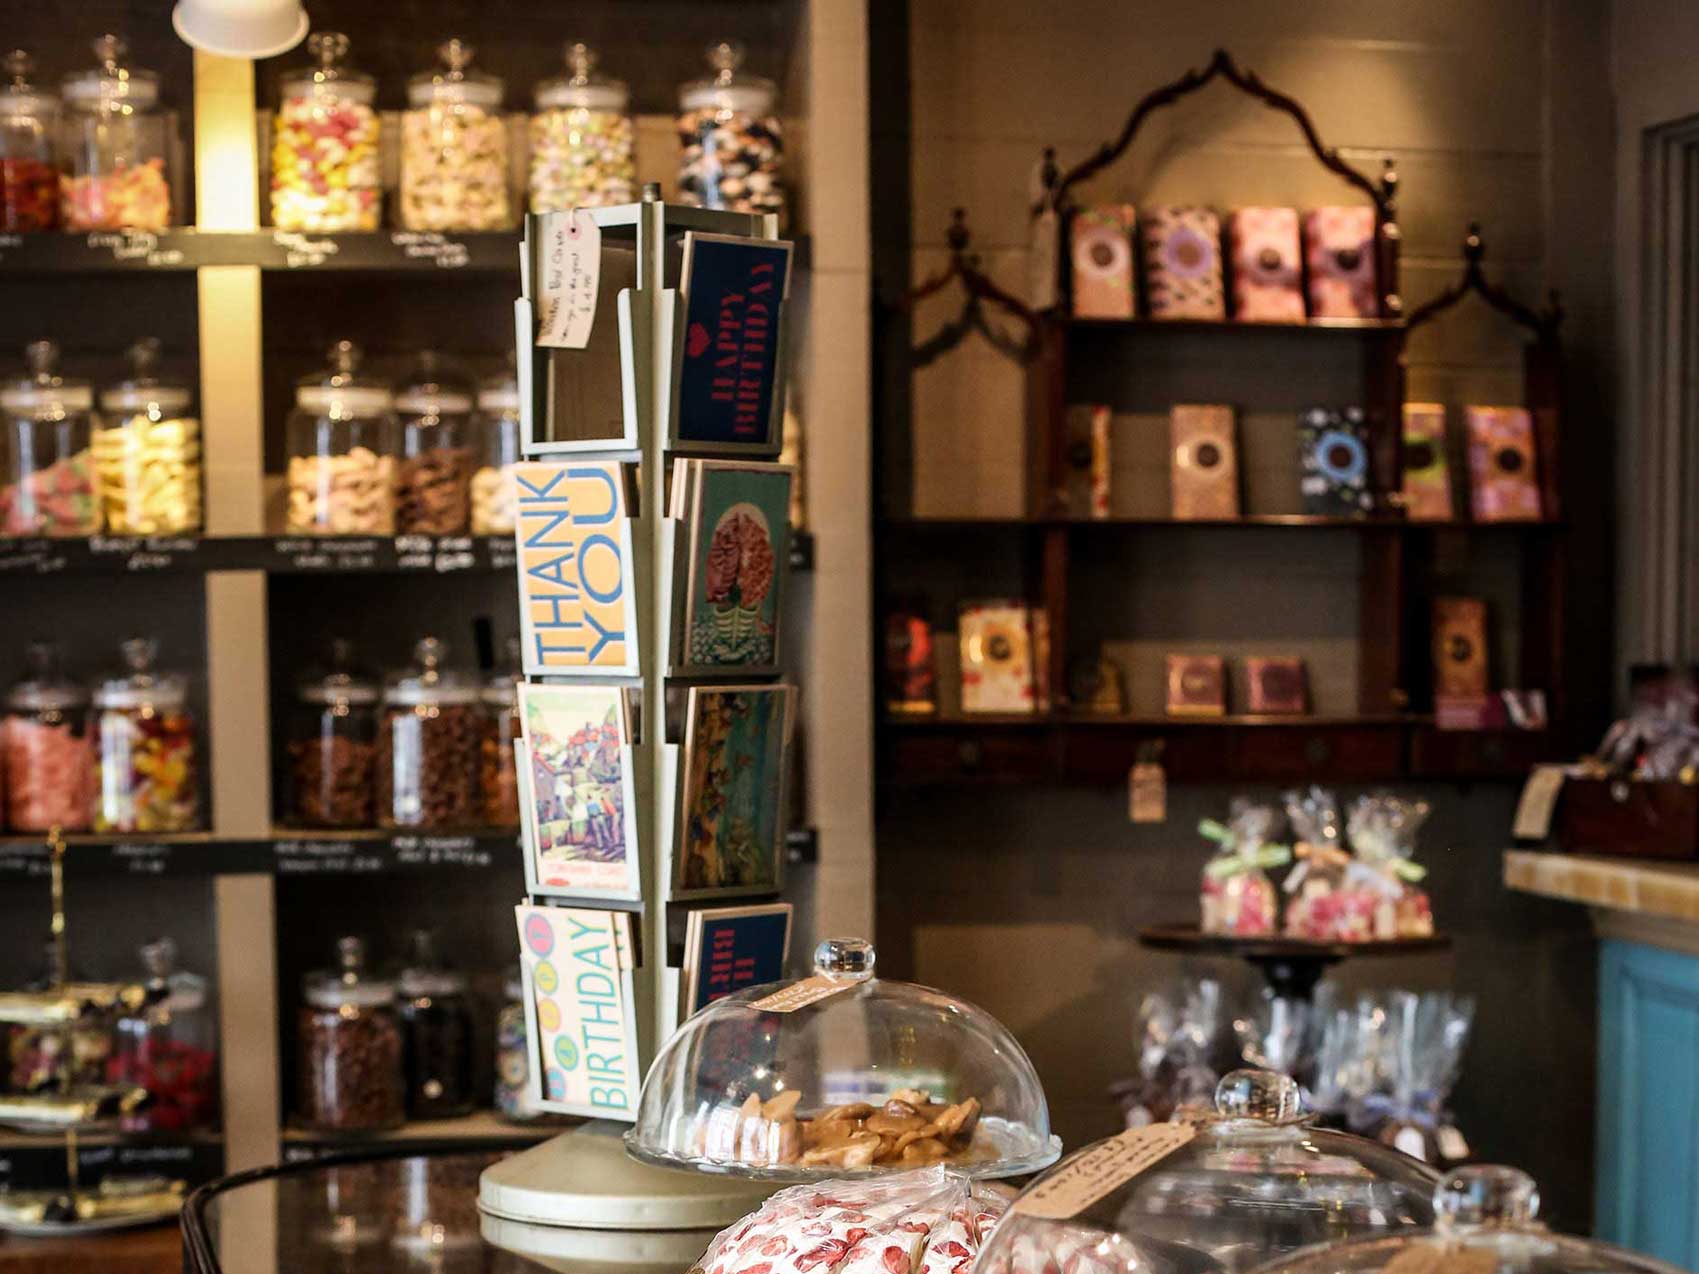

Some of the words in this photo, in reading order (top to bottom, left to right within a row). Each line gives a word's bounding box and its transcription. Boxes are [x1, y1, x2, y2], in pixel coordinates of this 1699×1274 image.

[711, 287, 746, 402] HAPPY
[733, 261, 775, 434] BIRTHDAY
[516, 470, 587, 665] THANK
[567, 468, 625, 663] YOU
[567, 916, 629, 1110] BIRTHDAY
